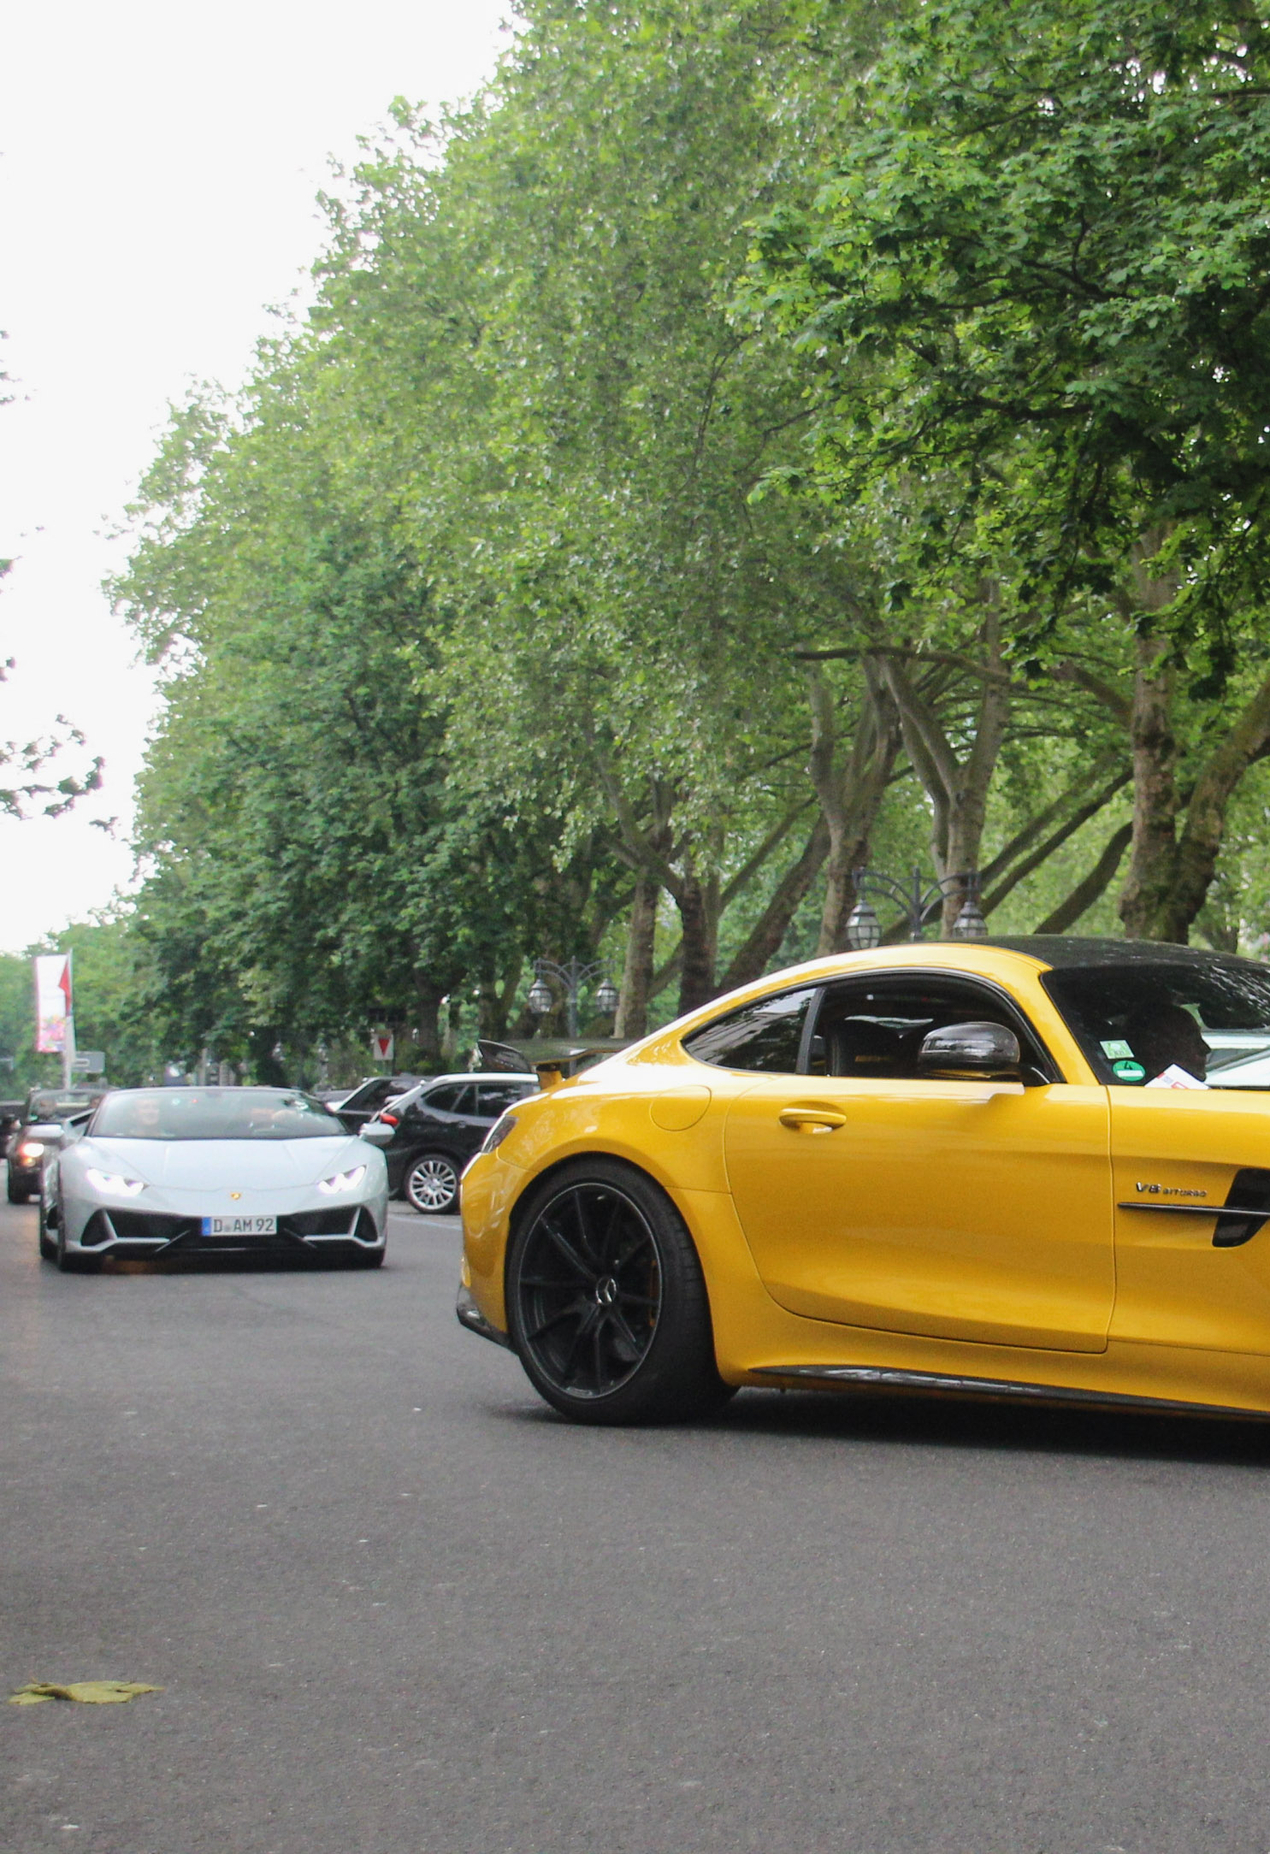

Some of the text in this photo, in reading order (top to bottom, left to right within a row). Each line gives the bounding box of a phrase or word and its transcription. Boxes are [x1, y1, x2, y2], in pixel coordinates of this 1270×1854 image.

[1136, 1182, 1208, 1198] V8 BITURBO
[213, 1218, 274, 1232] D AM 92
